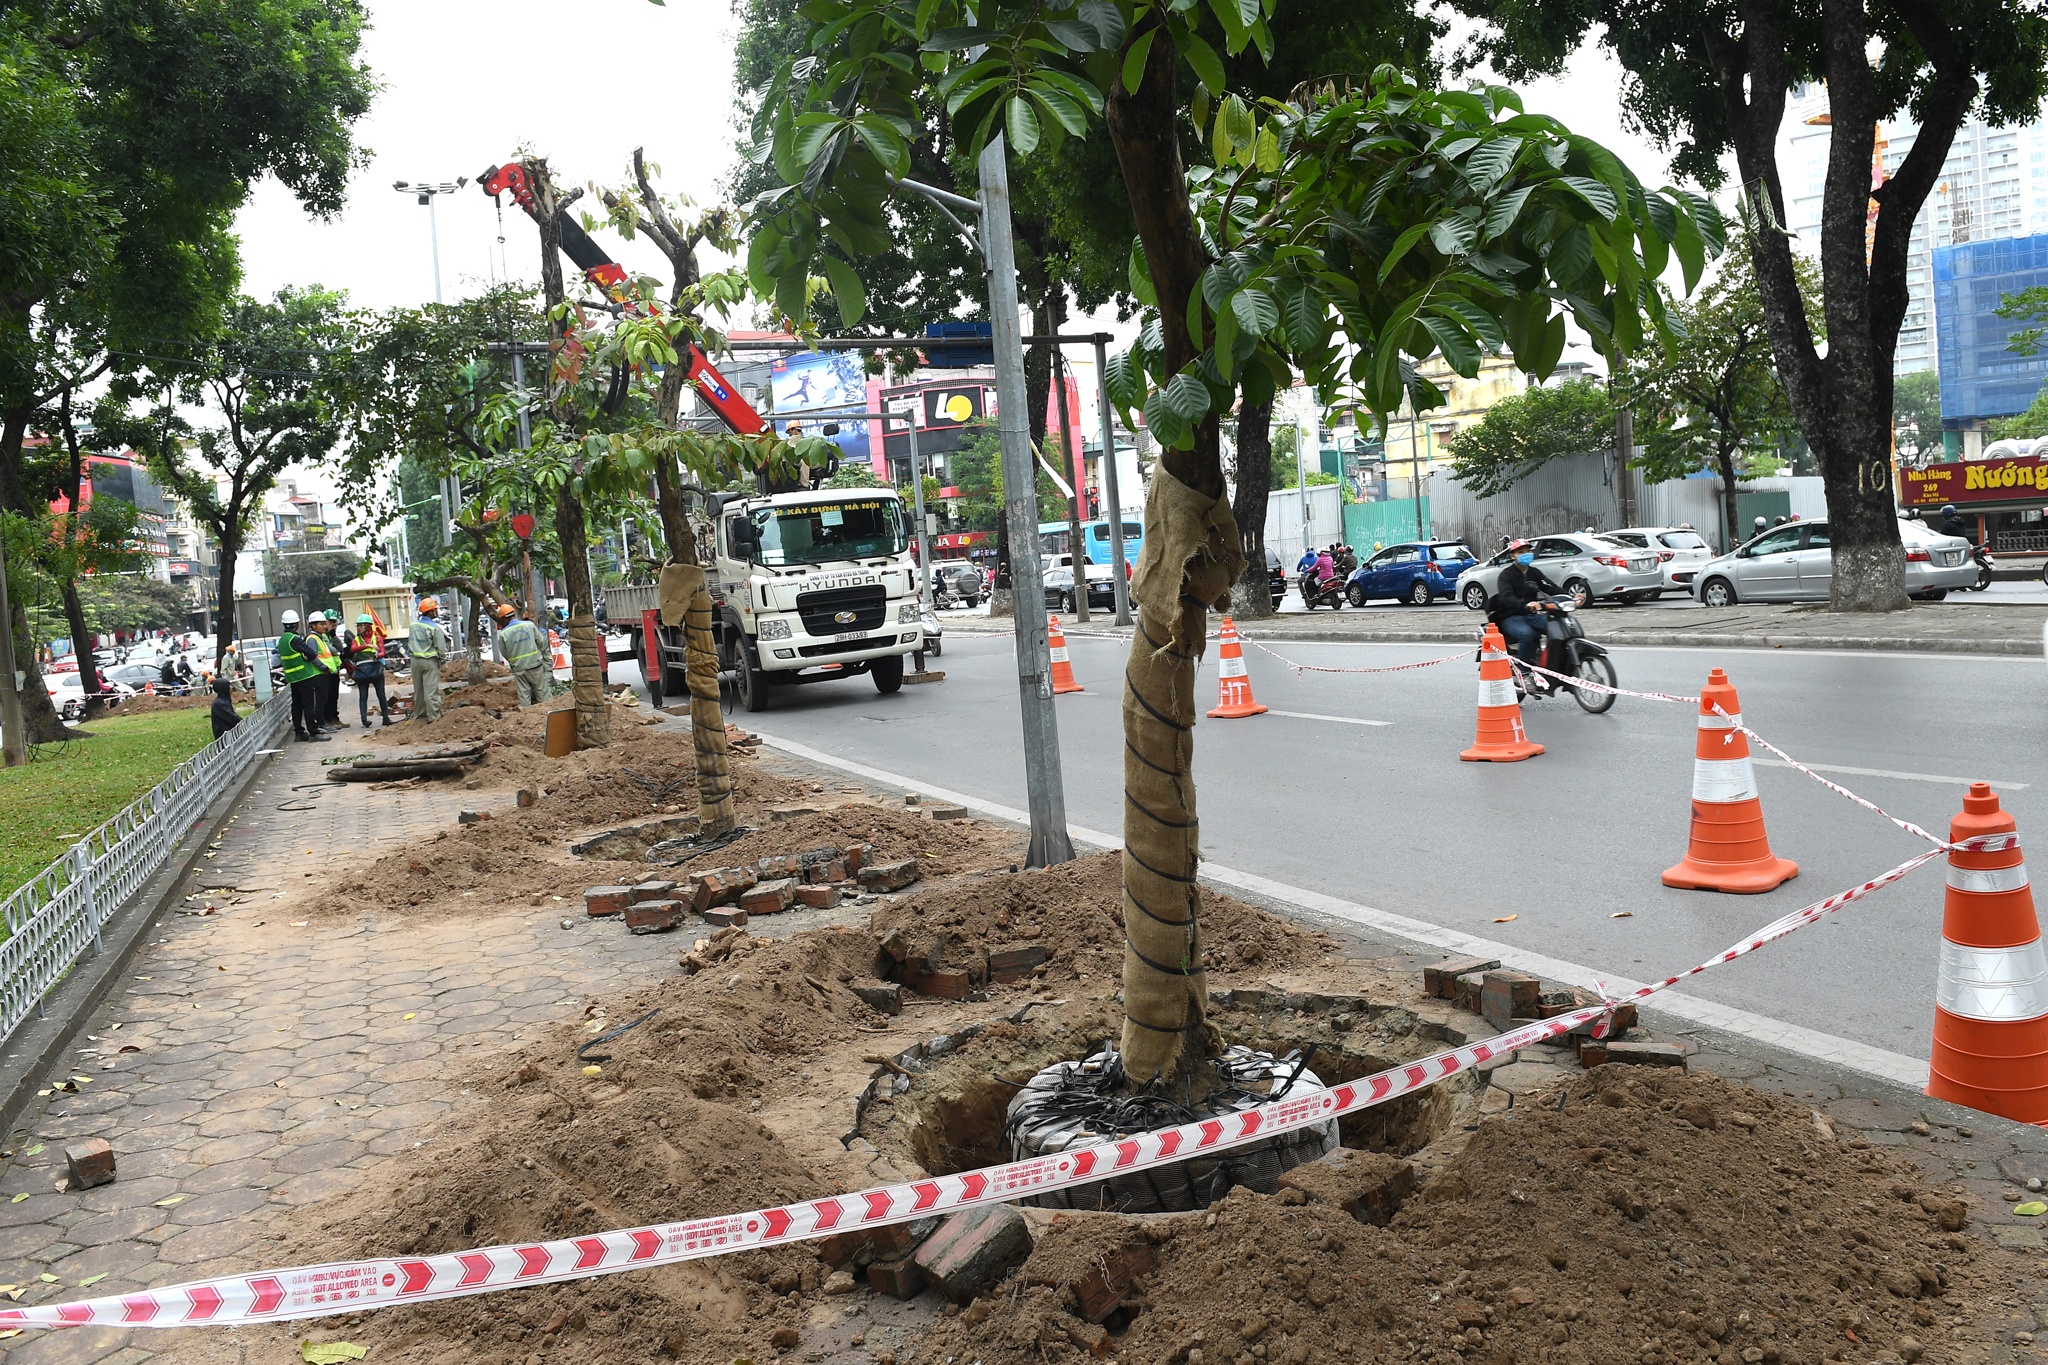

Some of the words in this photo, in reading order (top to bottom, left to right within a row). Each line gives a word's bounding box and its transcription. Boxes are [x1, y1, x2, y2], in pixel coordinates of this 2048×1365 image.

[1858, 460, 1886, 494] 10
[1908, 471, 1927, 481] Nhà
[1927, 469, 1952, 480] Hàng
[1965, 462, 2048, 490] Nướng
[1923, 483, 1938, 492] 269
[787, 506, 808, 515] XÂY
[844, 502, 859, 511] HÀ
[800, 575, 881, 591] HYUNDAI
[727, 1224, 743, 1234] AREA
[362, 1266, 377, 1276] VÀO
[328, 1279, 359, 1292] ALLOWED
[360, 1277, 377, 1288] AREA
